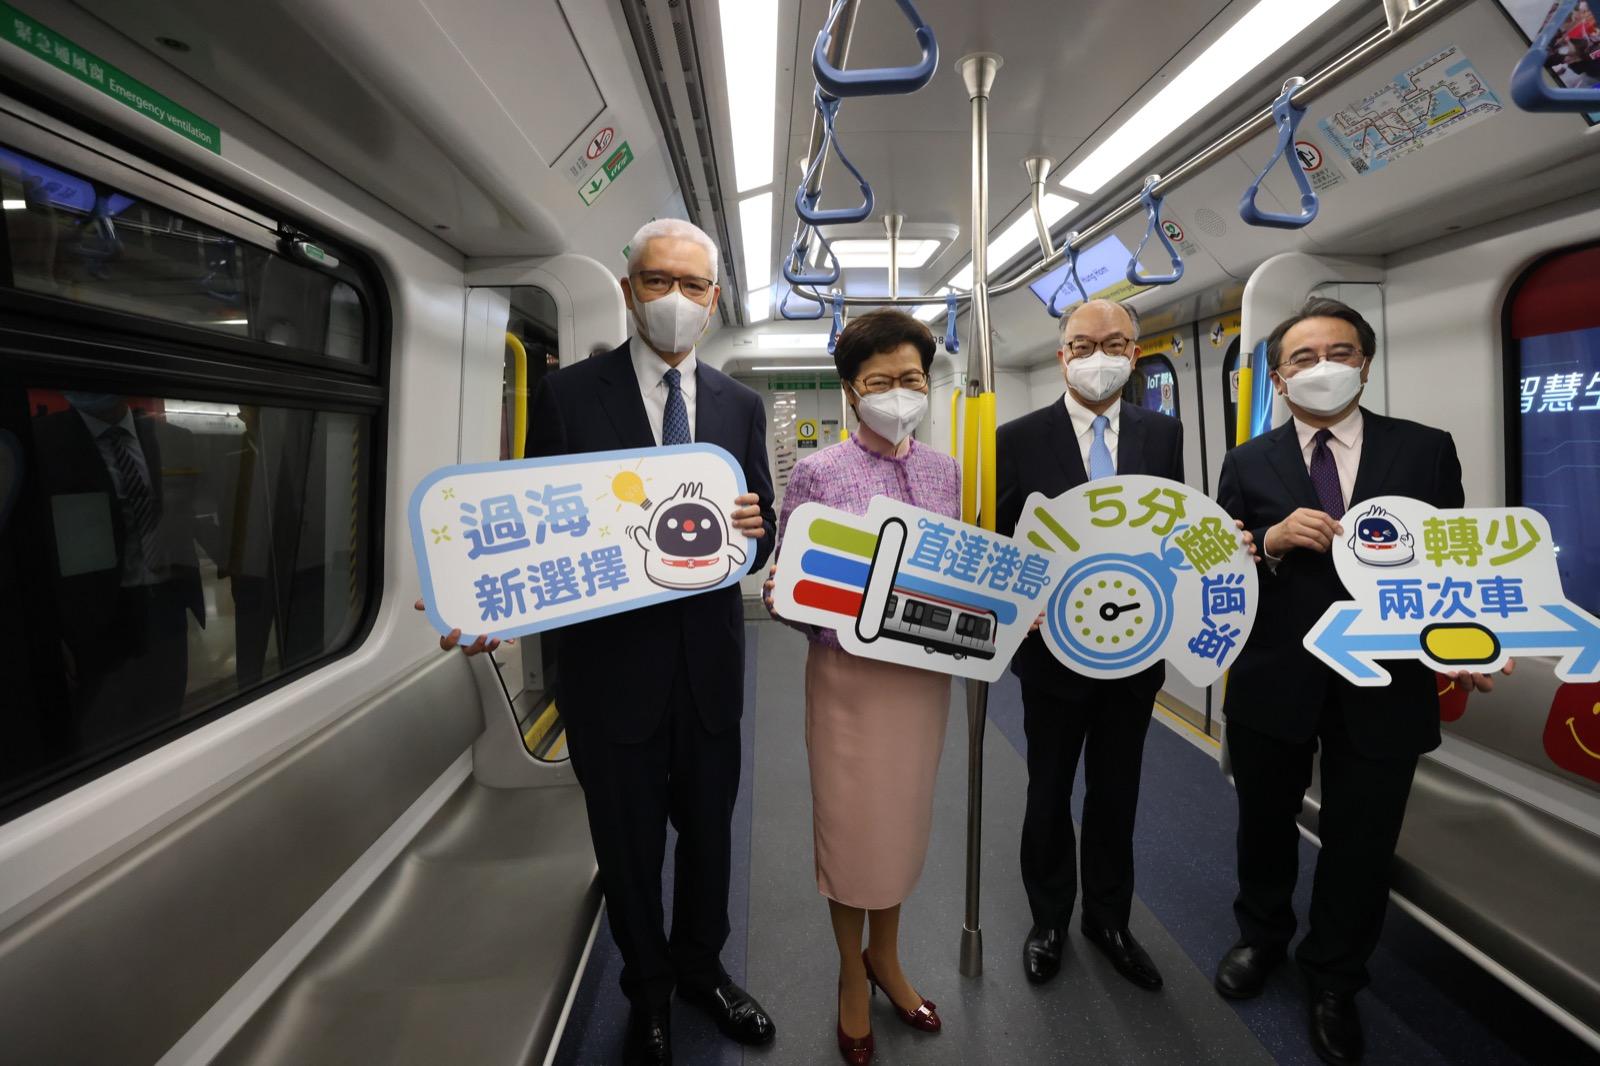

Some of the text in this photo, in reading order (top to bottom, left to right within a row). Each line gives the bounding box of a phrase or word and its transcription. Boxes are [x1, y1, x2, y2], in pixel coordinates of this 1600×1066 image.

[109, 78, 212, 144] Emergency ventilation
[1147, 373, 1160, 389] IoT
[460, 483, 590, 560] 過海
[1422, 514, 1541, 567] 轉少
[474, 545, 630, 621] 新選擇
[907, 517, 1050, 600] 直達港島
[1376, 575, 1528, 620] 兩次車
